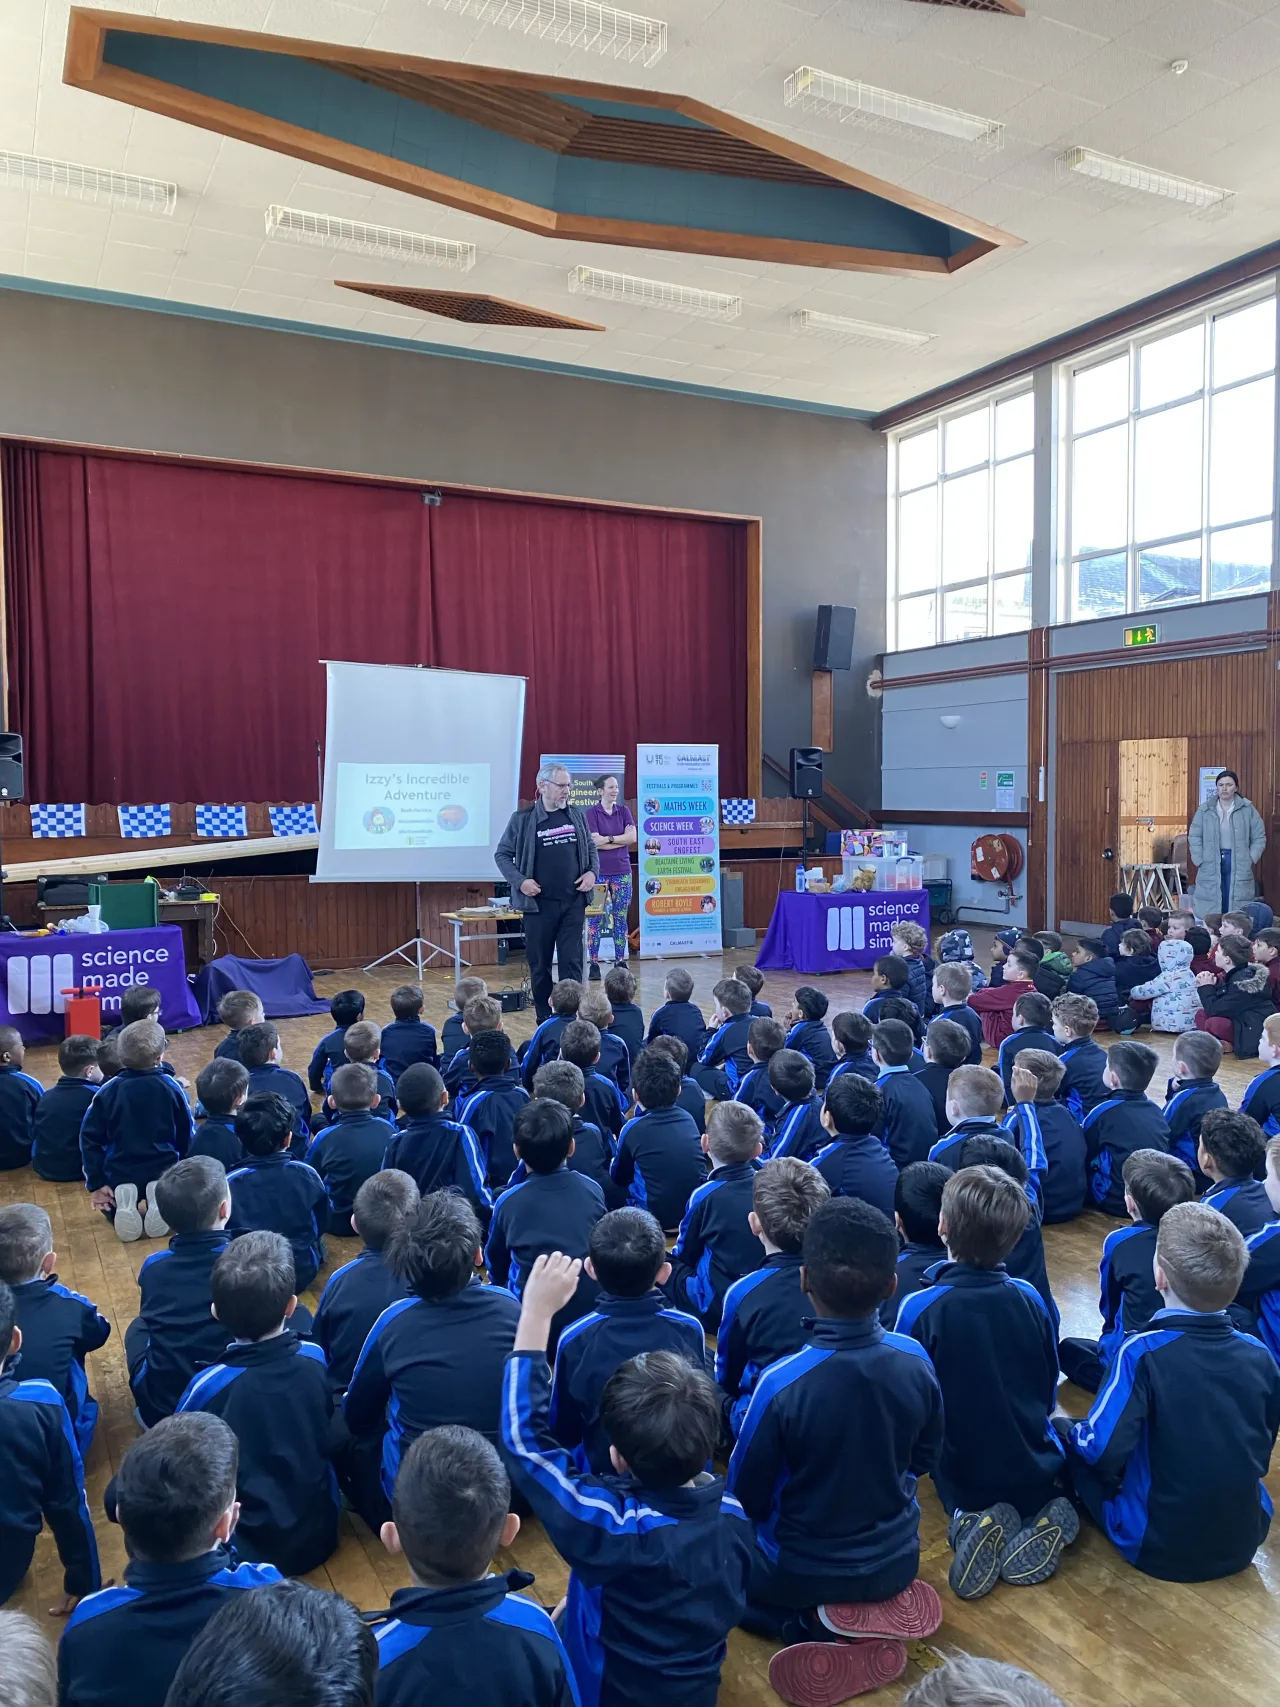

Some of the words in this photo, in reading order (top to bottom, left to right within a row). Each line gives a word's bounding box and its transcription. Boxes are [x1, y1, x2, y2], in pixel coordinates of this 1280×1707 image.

[365, 773, 402, 787] Izzy’s
[407, 773, 470, 784] Incredible
[384, 790, 451, 801] Adventure
[568, 788, 600, 797] gineeri
[664, 801, 686, 812] MATHS
[688, 800, 708, 810] WEEK
[650, 822, 674, 832] SCIENCE
[676, 822, 694, 831] WEEK
[652, 899, 674, 908] ROBERT
[675, 898, 692, 908] BOYLE
[868, 900, 920, 916] science
[870, 916, 908, 932] mad
[869, 934, 894, 949] sim
[82, 946, 168, 966] science
[82, 966, 149, 988] made
